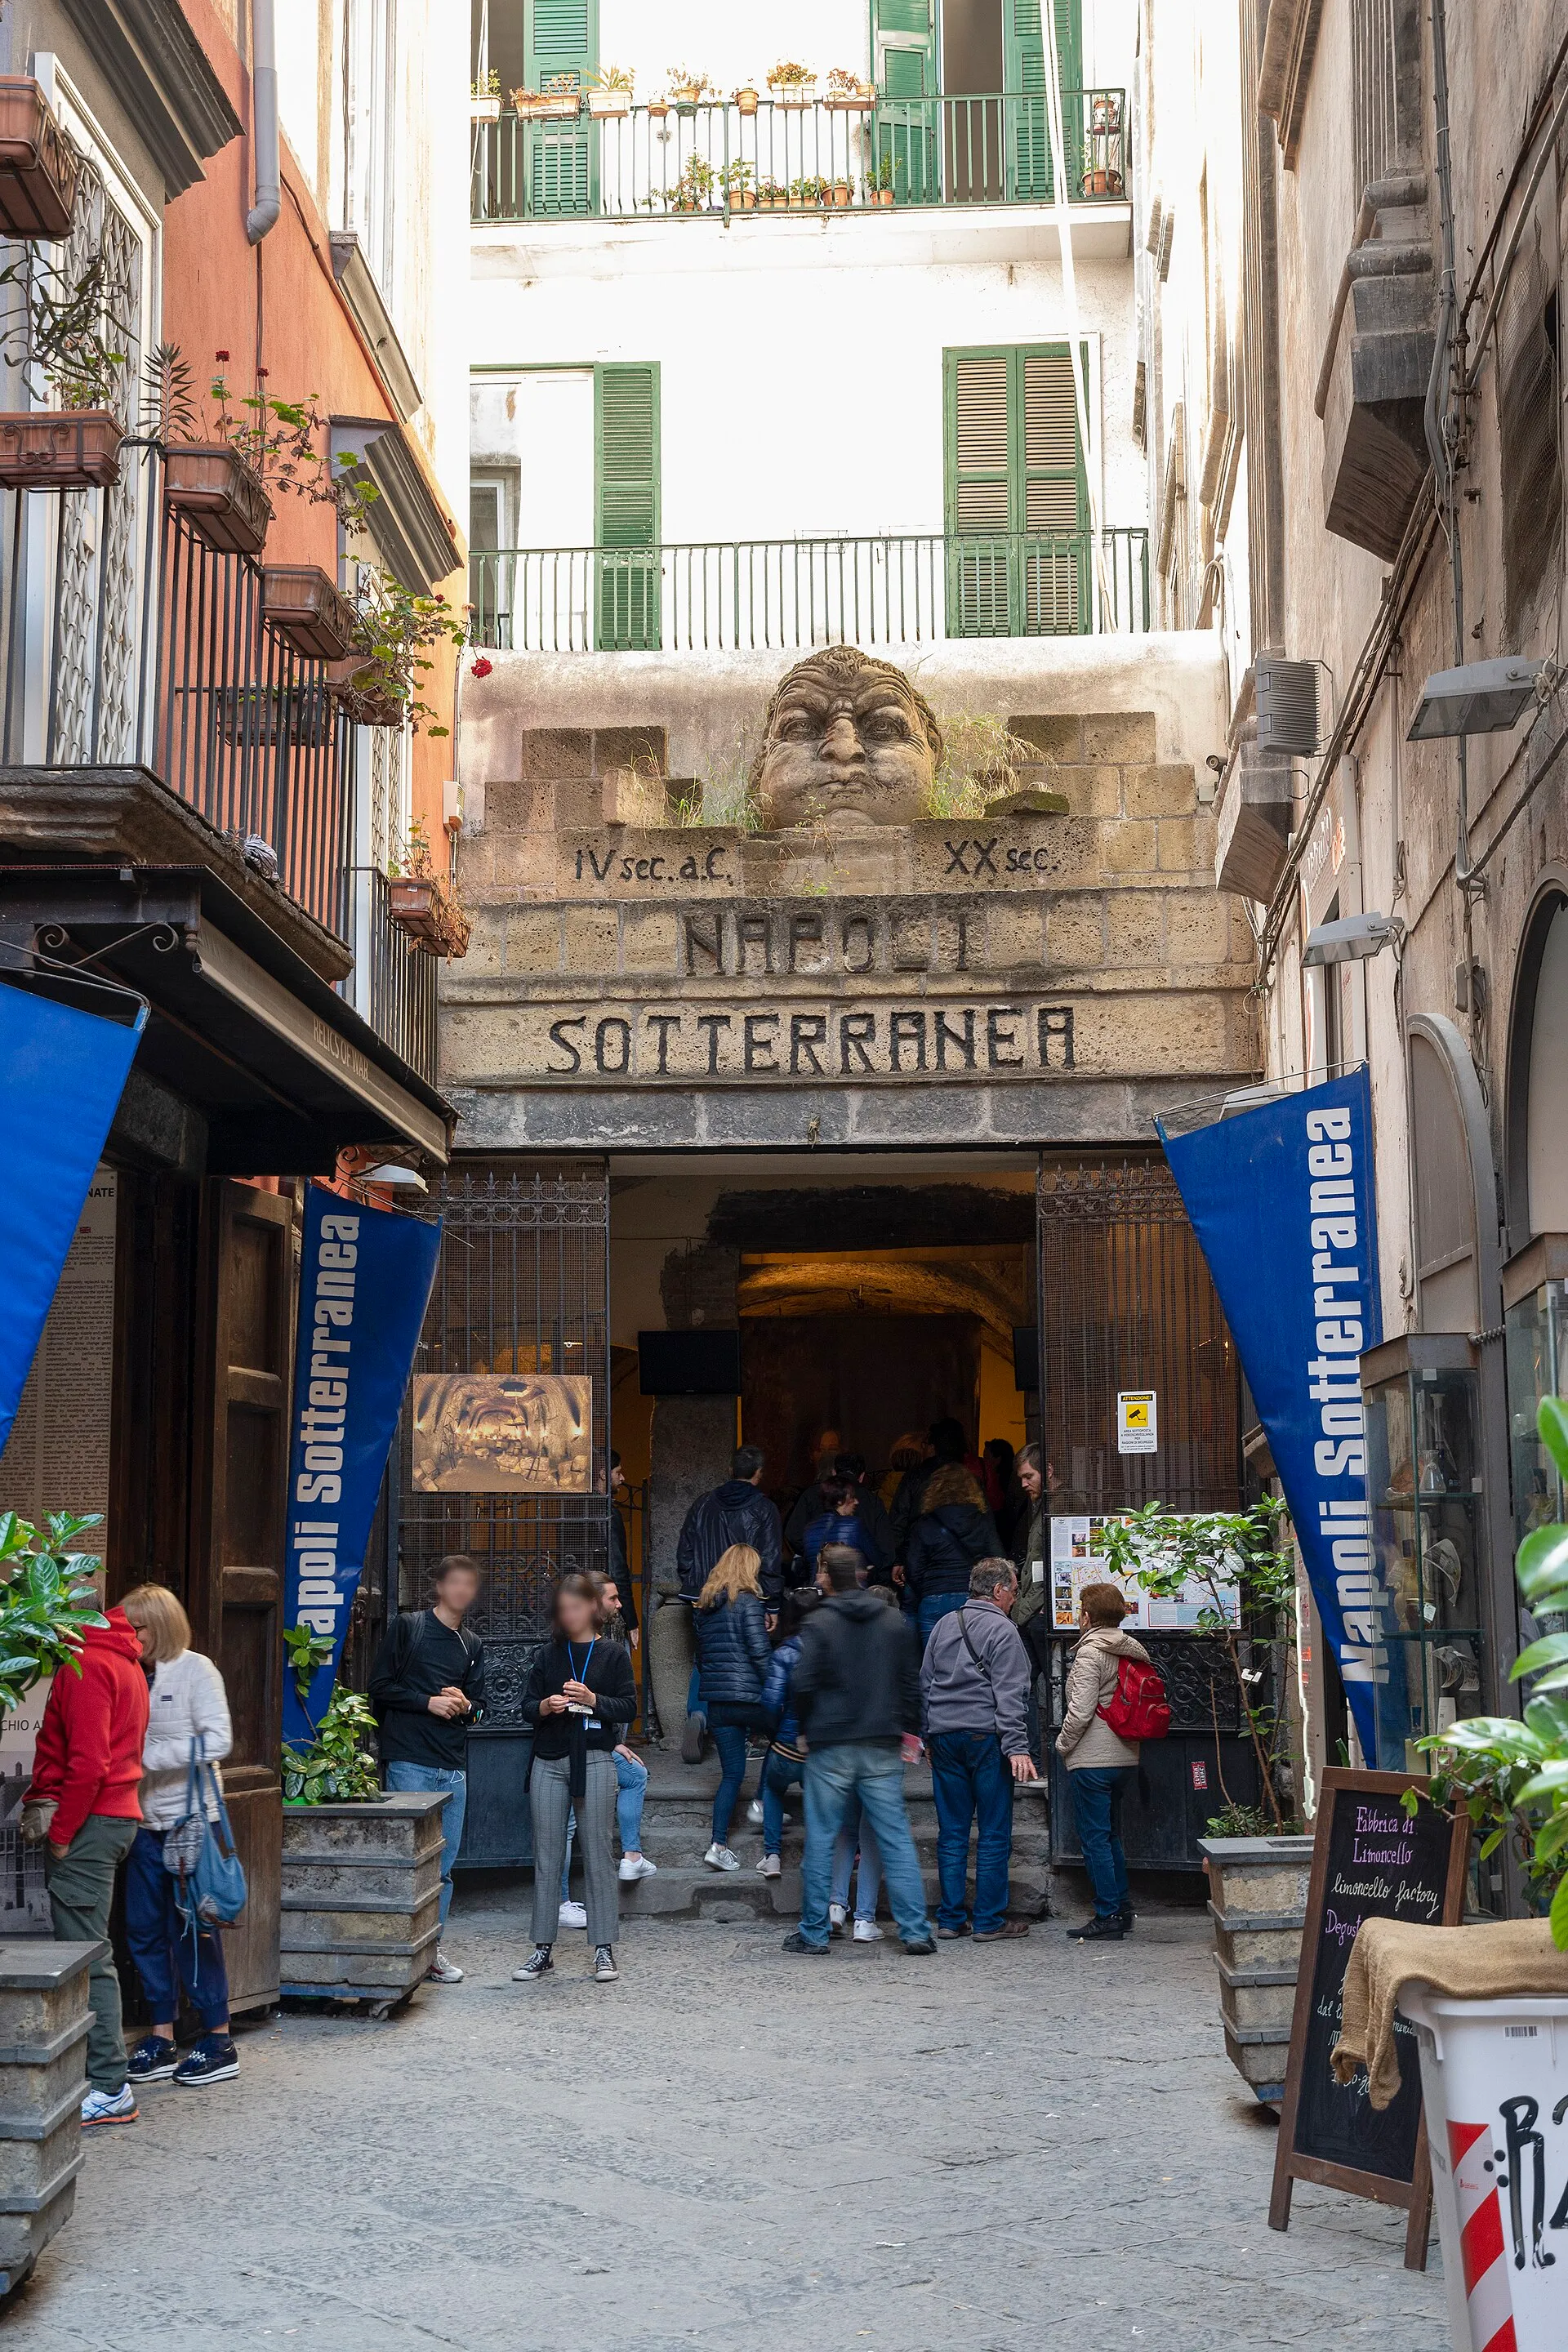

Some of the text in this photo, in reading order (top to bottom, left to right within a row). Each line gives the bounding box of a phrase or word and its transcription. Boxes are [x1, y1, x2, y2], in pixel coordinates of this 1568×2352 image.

[944, 839, 1058, 876] XX sec.
[684, 911, 969, 977] NAPOLI
[546, 1005, 1077, 1076] SOTTERRANEA
[296, 1214, 360, 1503] Sotterranea
[1307, 1107, 1389, 1684] Napoli Sotterranea
[1355, 1806, 1414, 1834] Fabbrica di
[1352, 1838, 1413, 1865] Limoncello
[1331, 1873, 1440, 1919] limoncello factory
